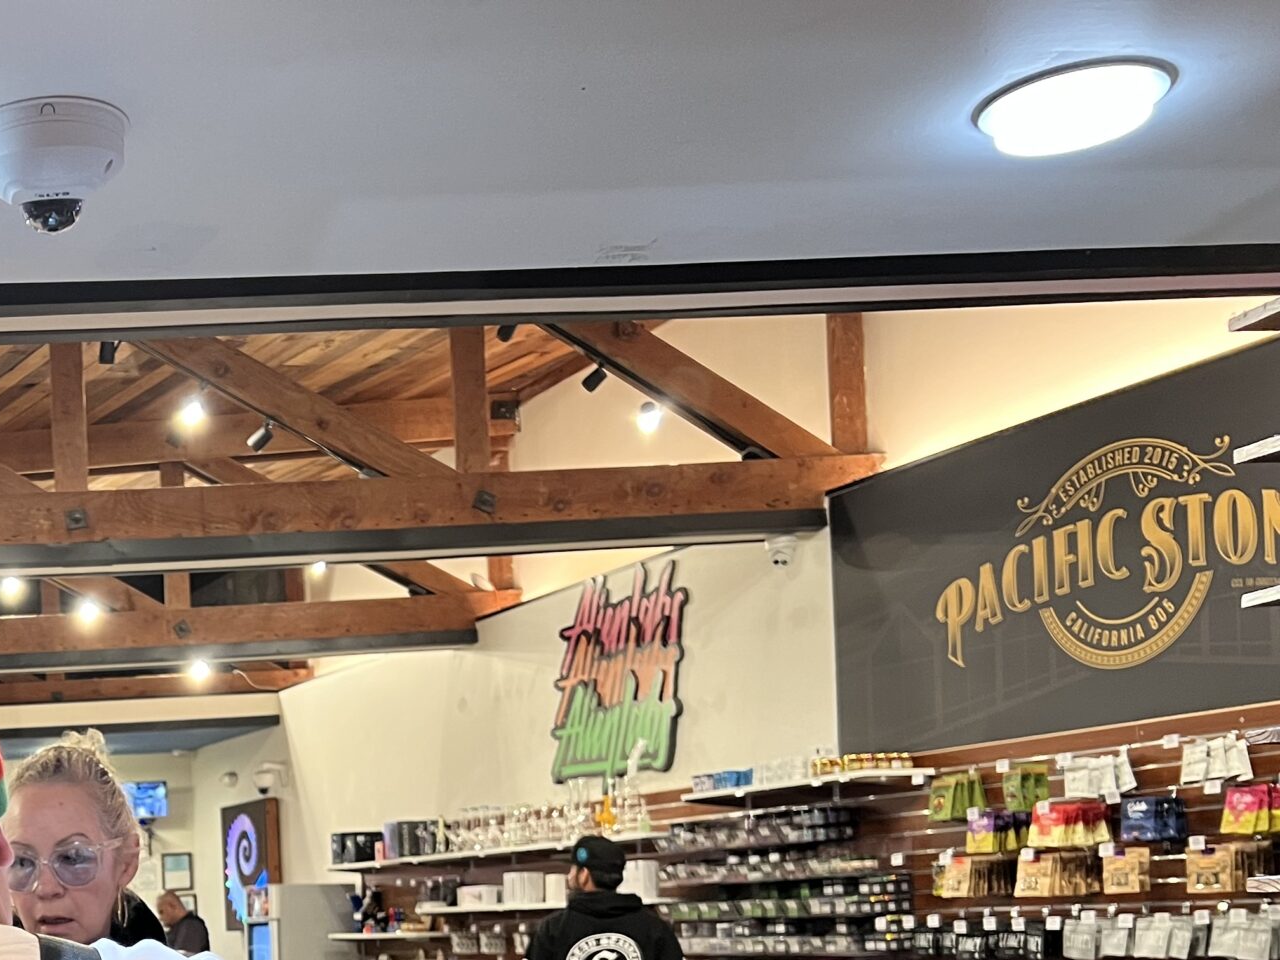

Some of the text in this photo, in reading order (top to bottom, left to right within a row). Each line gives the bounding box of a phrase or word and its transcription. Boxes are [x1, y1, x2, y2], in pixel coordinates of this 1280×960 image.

[1057, 446, 1180, 502] ESTABLISHED 2015
[935, 508, 1130, 668] PACIFIC
[1065, 598, 1176, 647] CALIFORNIA 805
